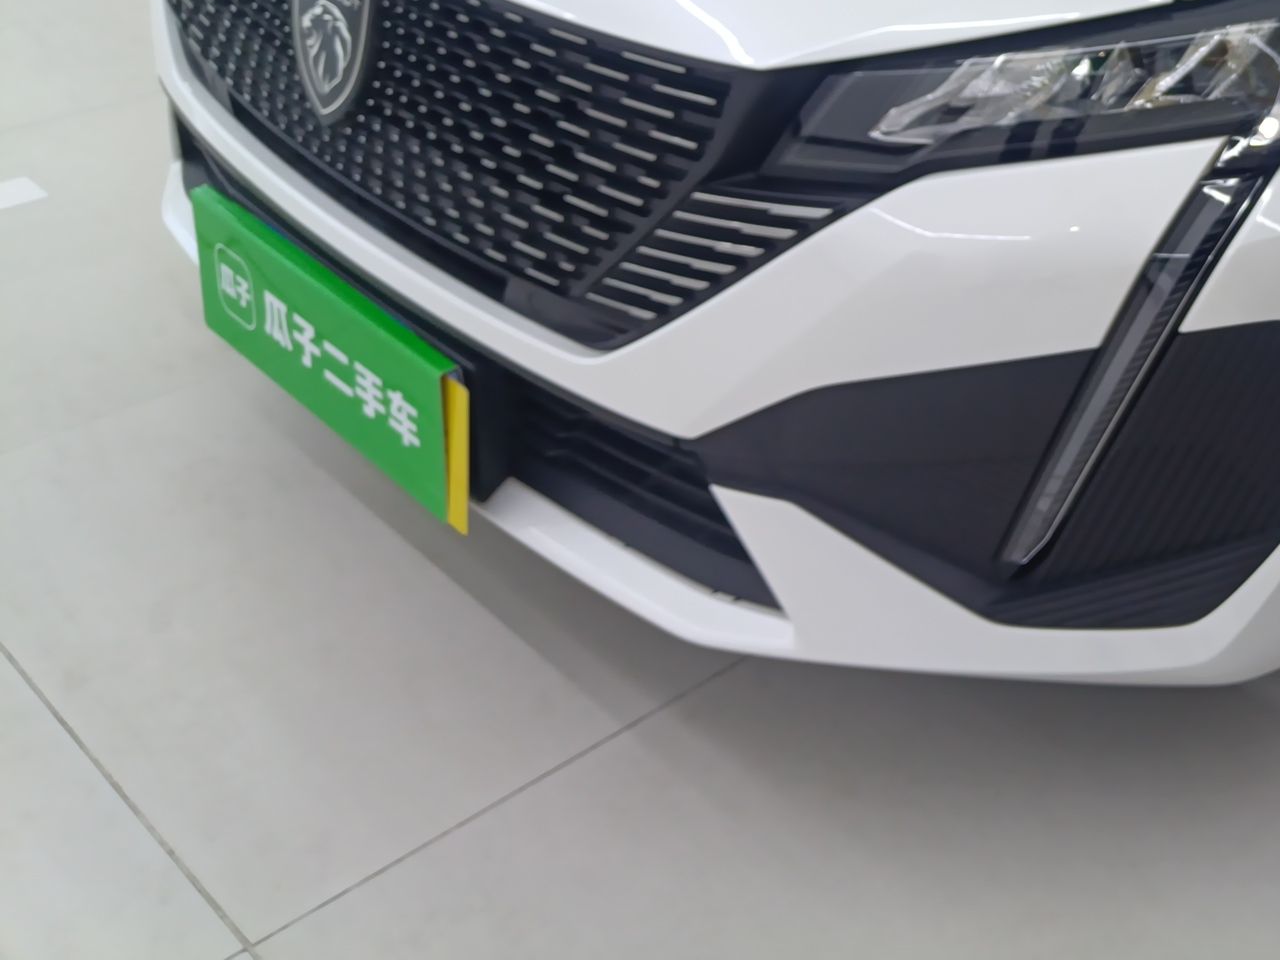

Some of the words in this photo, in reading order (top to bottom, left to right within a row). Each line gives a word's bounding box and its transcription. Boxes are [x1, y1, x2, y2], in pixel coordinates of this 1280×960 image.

[220, 261, 252, 308] 瓜子
[264, 289, 421, 448] 瓜子二手车
